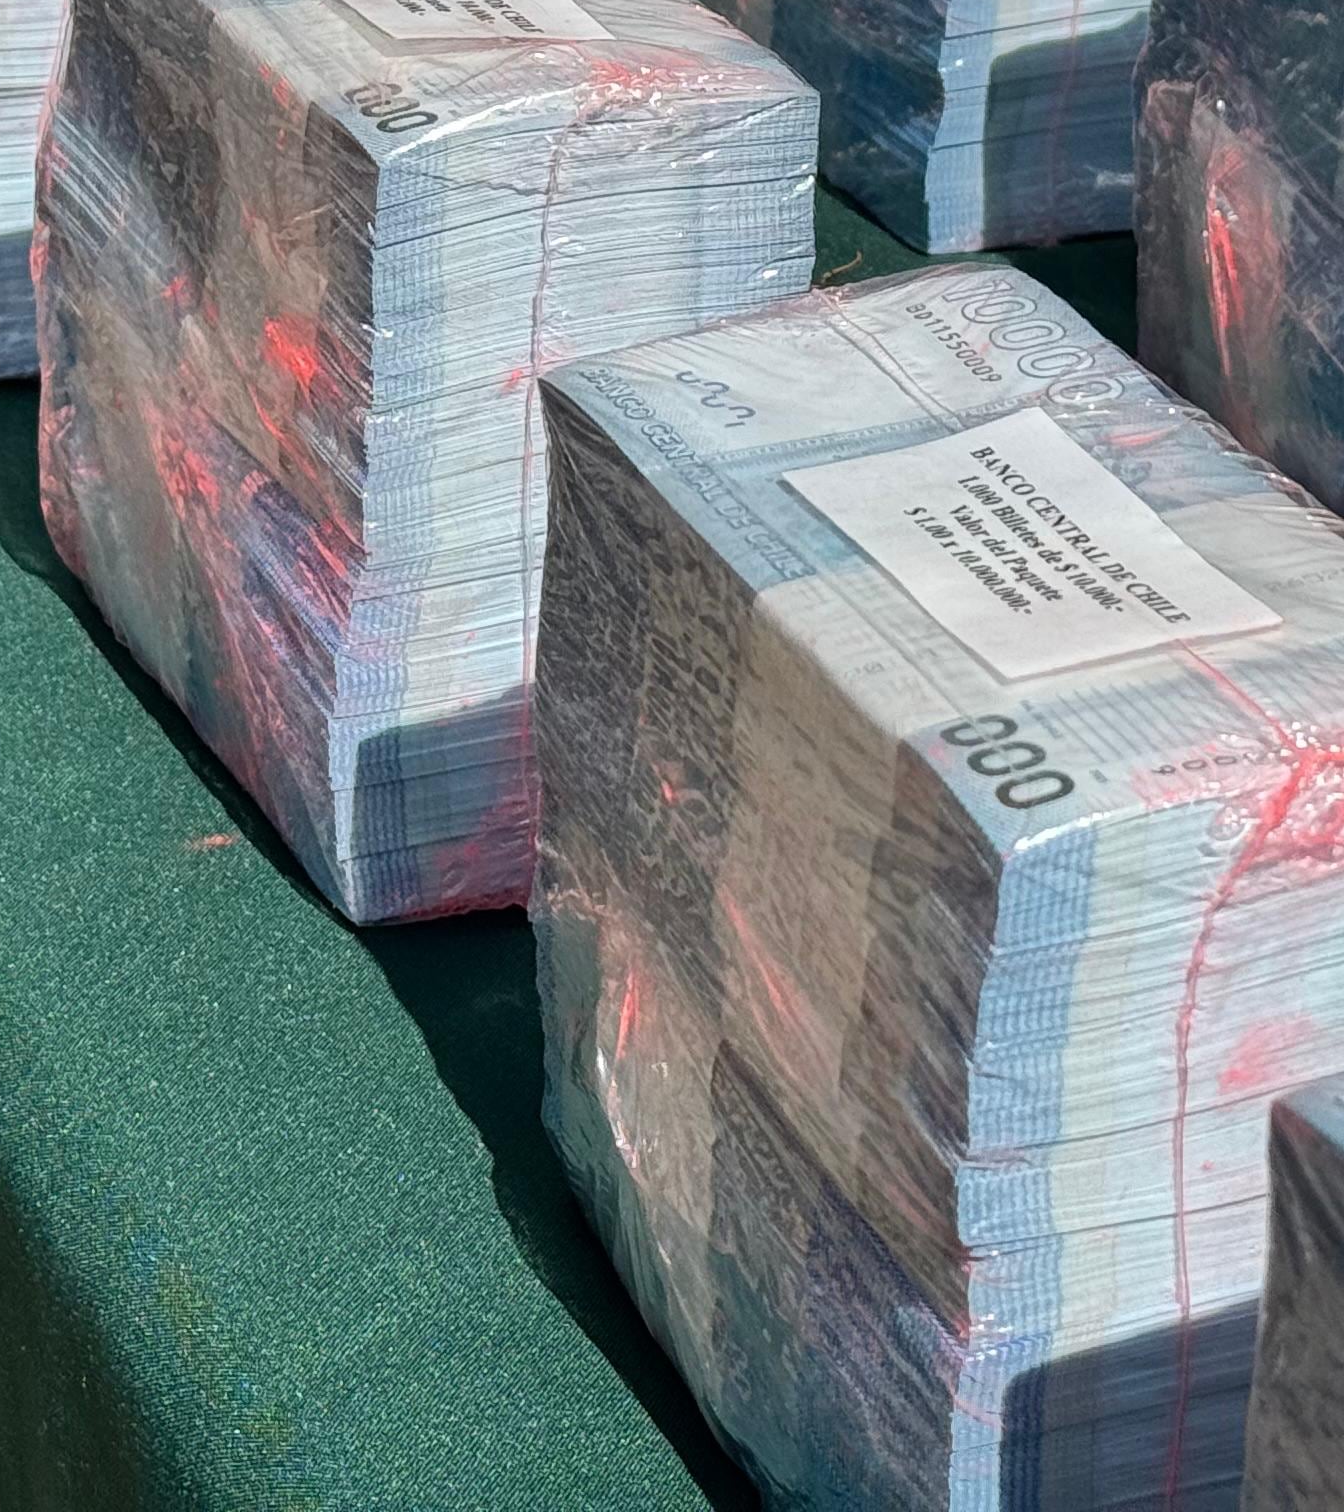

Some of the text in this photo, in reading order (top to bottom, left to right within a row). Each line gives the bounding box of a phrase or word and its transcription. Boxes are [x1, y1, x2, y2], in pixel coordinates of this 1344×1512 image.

[940, 278, 1126, 405] 10000
[578, 368, 817, 580] BANCO CENTRAL DE CHILE
[969, 446, 1192, 625] BANCO CENTRAL DE CHILE
[903, 506, 1033, 616] $ 1.00 x 10.000.000.-
[950, 503, 1063, 602] Valor del Paquete
[958, 475, 1124, 613] 1.000 Billetes de $ 10.000.-
[939, 714, 1075, 810] 000
